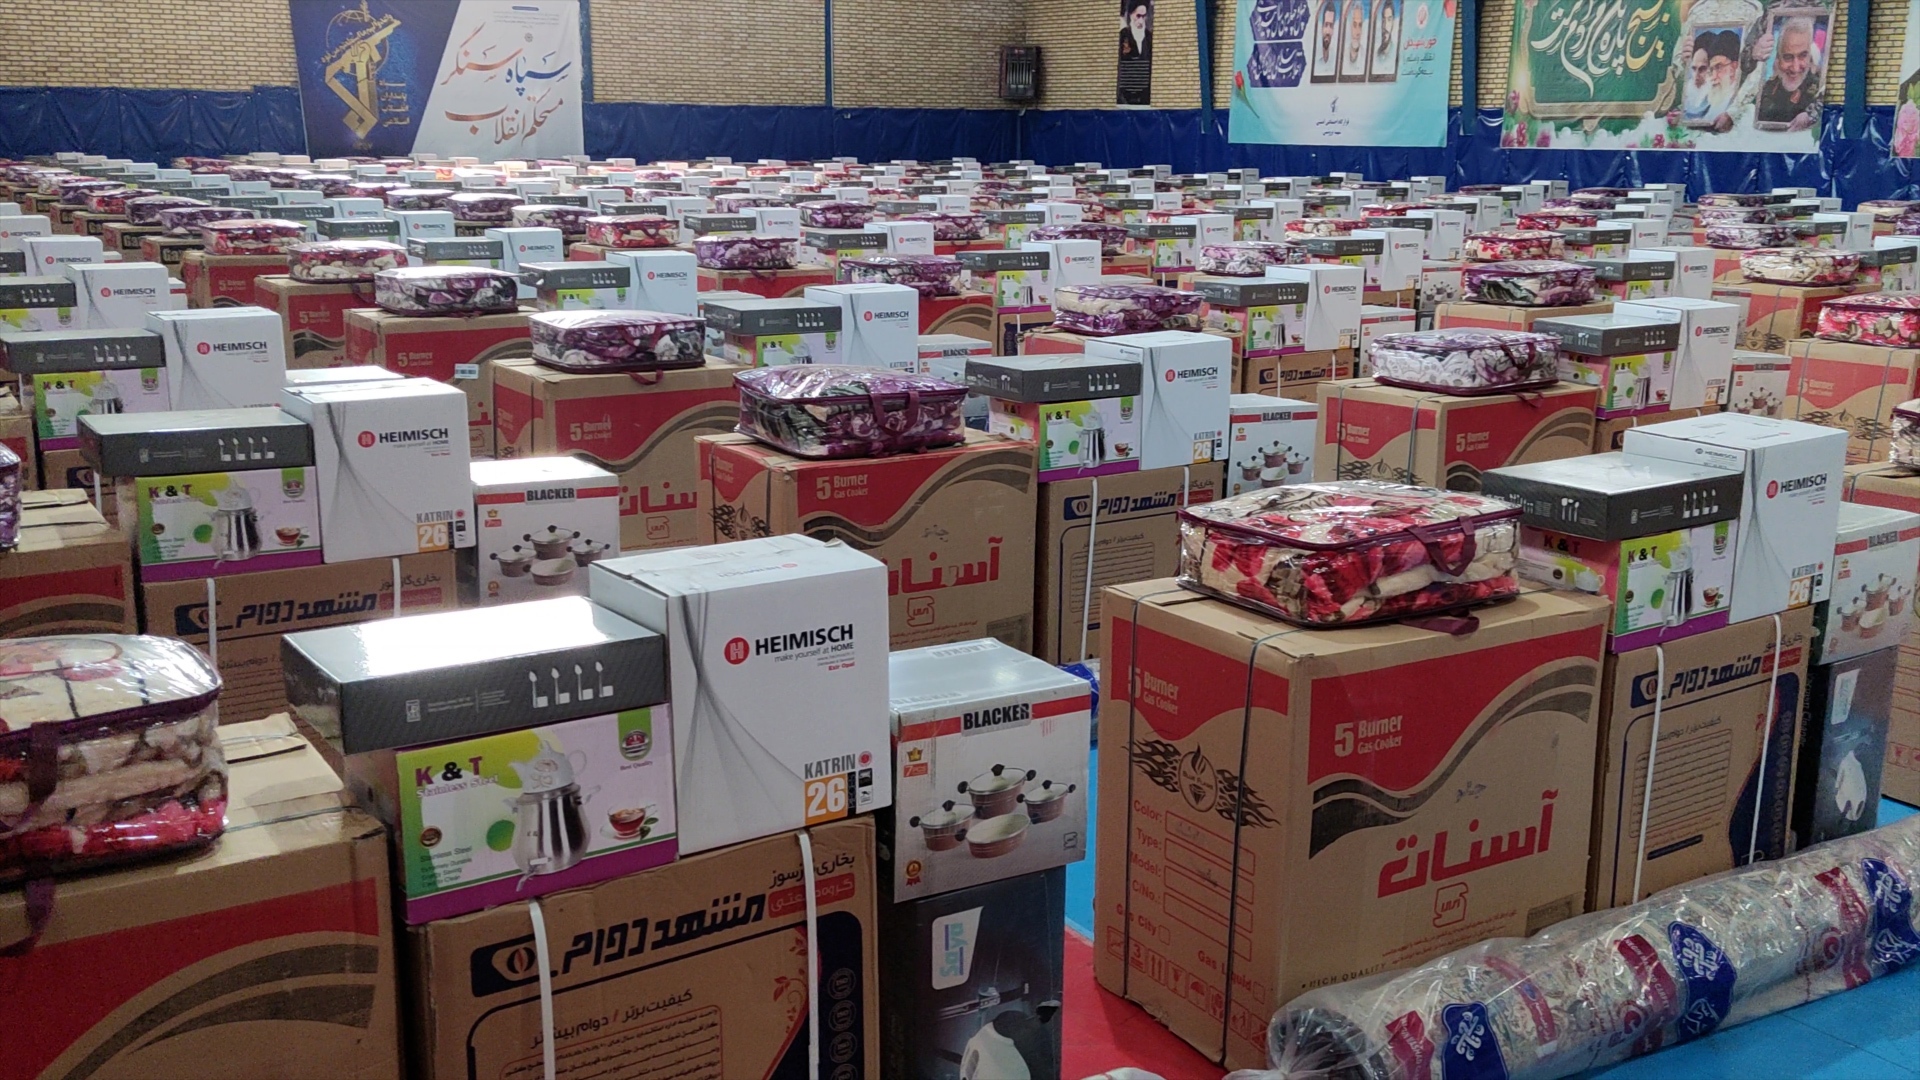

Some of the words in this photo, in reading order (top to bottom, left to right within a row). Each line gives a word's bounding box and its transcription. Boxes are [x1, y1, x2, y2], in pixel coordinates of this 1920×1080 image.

[440, 22, 524, 85] سنگر
[505, 51, 572, 96] سپاه
[445, 104, 526, 145] انقلاب
[521, 87, 564, 146] مستحکم
[113, 287, 156, 295] HEIMISCH
[300, 312, 308, 324] 5
[874, 310, 910, 321] HEIMISCH
[1703, 326, 1730, 336] HEIMISCH
[213, 341, 268, 352] HEIMISCH
[398, 352, 408, 366] 5
[1177, 366, 1218, 380] HEIMISCH
[1262, 412, 1292, 422] BLACKER
[379, 428, 448, 444] HEIMISCH
[570, 423, 582, 442] 5
[1194, 430, 1215, 441] KATRIN
[1456, 433, 1466, 452] 5
[1194, 442, 1212, 460] 26
[526, 487, 574, 502] BLACKER
[816, 476, 831, 500] 5
[834, 473, 868, 488] Burner
[1780, 473, 1828, 494] HEIMISCH
[1130, 491, 1176, 512] مشهد
[416, 510, 453, 524] KATRIN
[418, 525, 448, 548] 26
[1868, 530, 1898, 548] BLACKER
[1790, 578, 1810, 605] 26
[236, 600, 292, 629] دوام
[296, 592, 378, 620] مشهد
[755, 624, 854, 656] HEIMISCH
[774, 652, 794, 663] make
[795, 648, 822, 662] yourself
[822, 646, 830, 654] at
[830, 642, 854, 652] HOME
[1667, 666, 1708, 698] دوام
[1707, 654, 1762, 688] مشهد
[1144, 671, 1179, 700] Burner
[962, 702, 1030, 731] BLACKER
[1334, 722, 1355, 758] 5
[1358, 714, 1403, 740] Burner
[804, 754, 856, 780] KATRIN
[416, 782, 468, 798] Stainless
[470, 774, 499, 789] Steel
[806, 777, 846, 818] 26
[1134, 800, 1162, 823] Color:
[1136, 828, 1162, 850] Type:
[1378, 788, 1559, 898] آسنات
[815, 854, 856, 876] بخاری
[1130, 851, 1162, 878] Model:
[651, 892, 766, 950] مشهد
[1116, 903, 1134, 922] Gs
[1138, 916, 1157, 936] City
[562, 917, 648, 974] دوام
[1198, 950, 1217, 970] Gas
[1221, 962, 1252, 990] Lquid
[1342, 962, 1387, 982] QUALITY
[646, 989, 693, 1013] کیفیت
[622, 1002, 648, 1024] برتر
[576, 1015, 608, 1036] دوام
